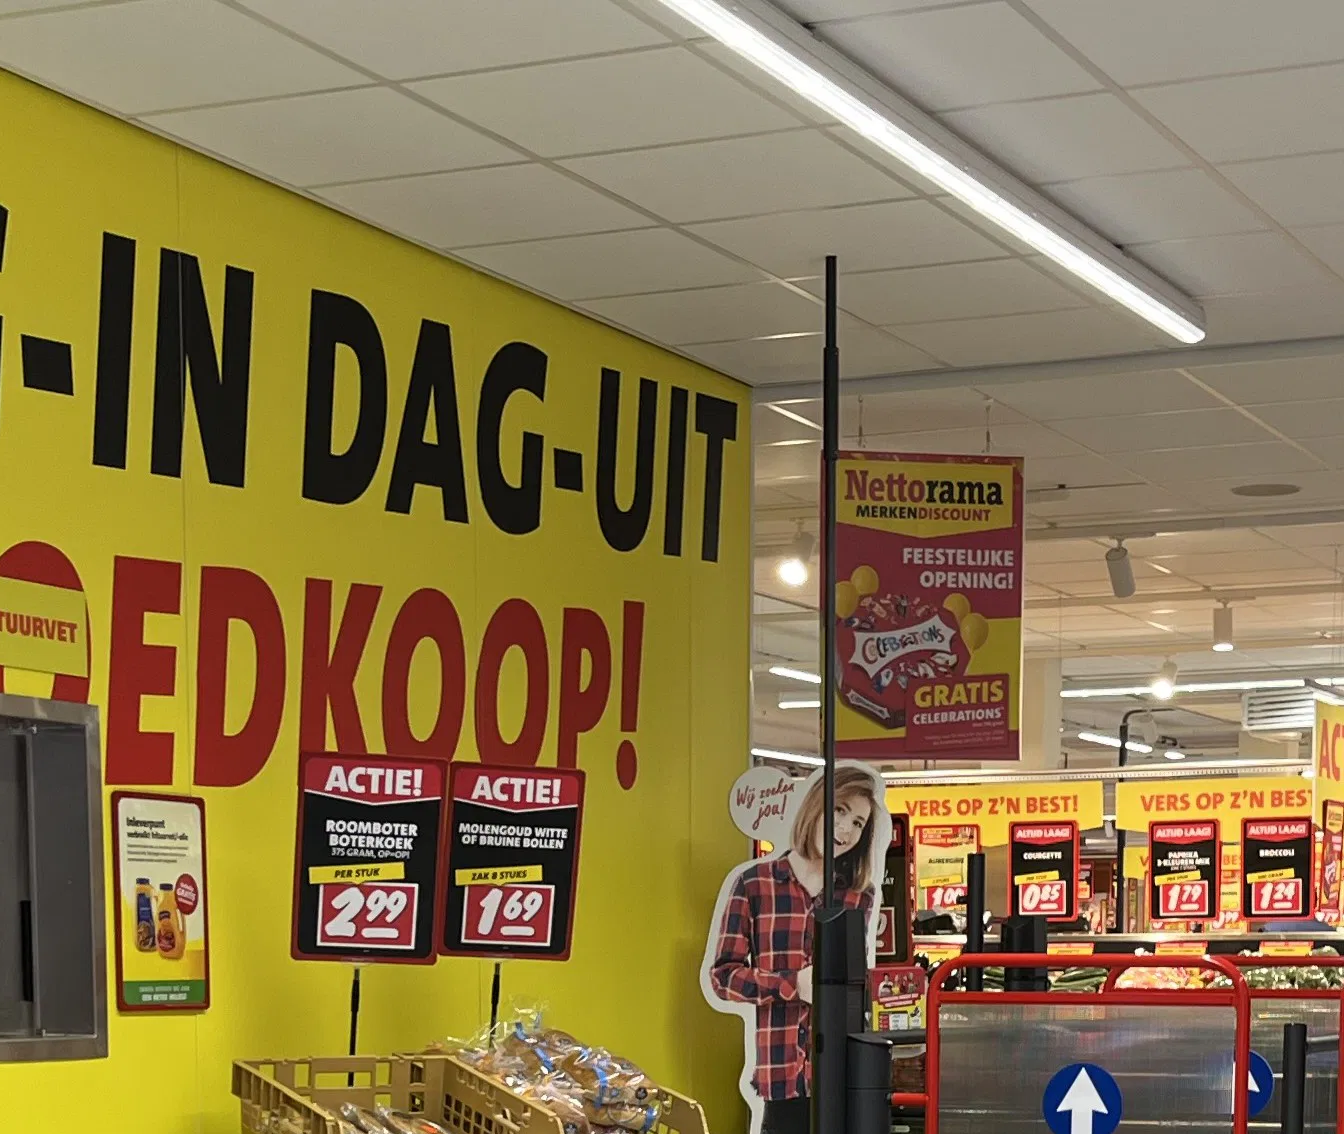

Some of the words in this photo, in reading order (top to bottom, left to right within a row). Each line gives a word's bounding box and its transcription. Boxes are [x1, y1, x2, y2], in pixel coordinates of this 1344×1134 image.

[301, 288, 739, 563] DAG-UIT
[844, 469, 1004, 506] Nettorama
[856, 505, 991, 522] MERKENDISCOUNT
[903, 548, 1014, 567] FEESTELIJKE
[919, 571, 1014, 590] OPENING!
[914, 680, 1004, 708] GRATIS
[913, 708, 1002, 725] CELEBRATIONS
[324, 765, 424, 796] ACTIE!
[471, 776, 562, 804] ACTIE!
[736, 785, 756, 809] Wij
[905, 799, 952, 817] VERS
[956, 798, 983, 816] OP
[1026, 794, 1078, 814] BEST!
[1140, 793, 1191, 812] VERS
[1196, 792, 1224, 810] OP
[752, 794, 787, 830] jou!
[326, 819, 418, 837] ROOMBOTER
[458, 822, 533, 837] MOLENGOUD
[534, 827, 568, 838] WITTE
[329, 834, 414, 850] BOTERKOEK
[461, 834, 478, 845] OF
[479, 835, 521, 847] BRUINE
[522, 837, 565, 849] BOLLEN
[331, 847, 346, 857] 375
[346, 848, 377, 859] GRAM,
[1023, 851, 1062, 860] COURGETTE
[1259, 849, 1295, 858] BROCCOLI
[334, 869, 353, 878] PER
[355, 867, 381, 877] STUK
[471, 872, 489, 881] ZAK
[500, 870, 528, 879] STUKS
